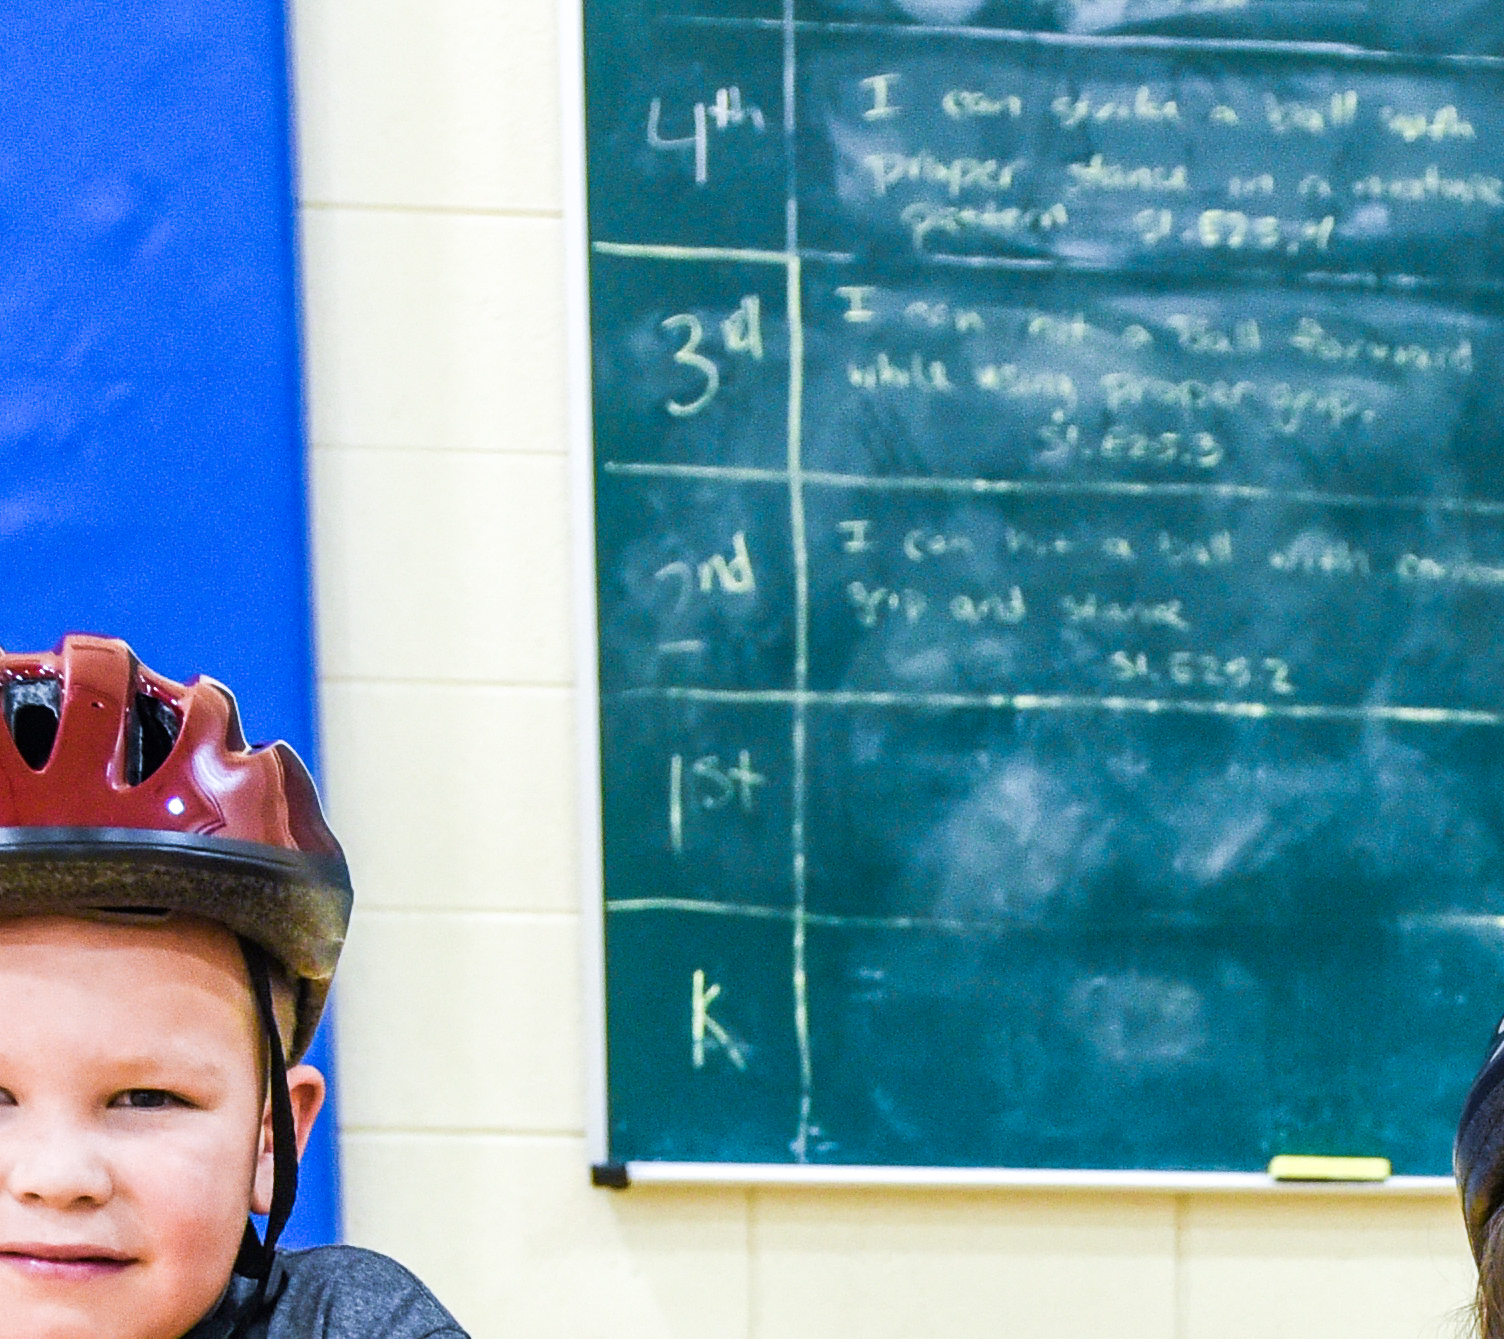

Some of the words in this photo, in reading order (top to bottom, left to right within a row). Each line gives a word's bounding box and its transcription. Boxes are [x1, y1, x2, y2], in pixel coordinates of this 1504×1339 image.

[859, 74, 901, 121] I
[647, 85, 766, 186] 4th
[835, 285, 877, 323] I
[837, 518, 874, 553] I
